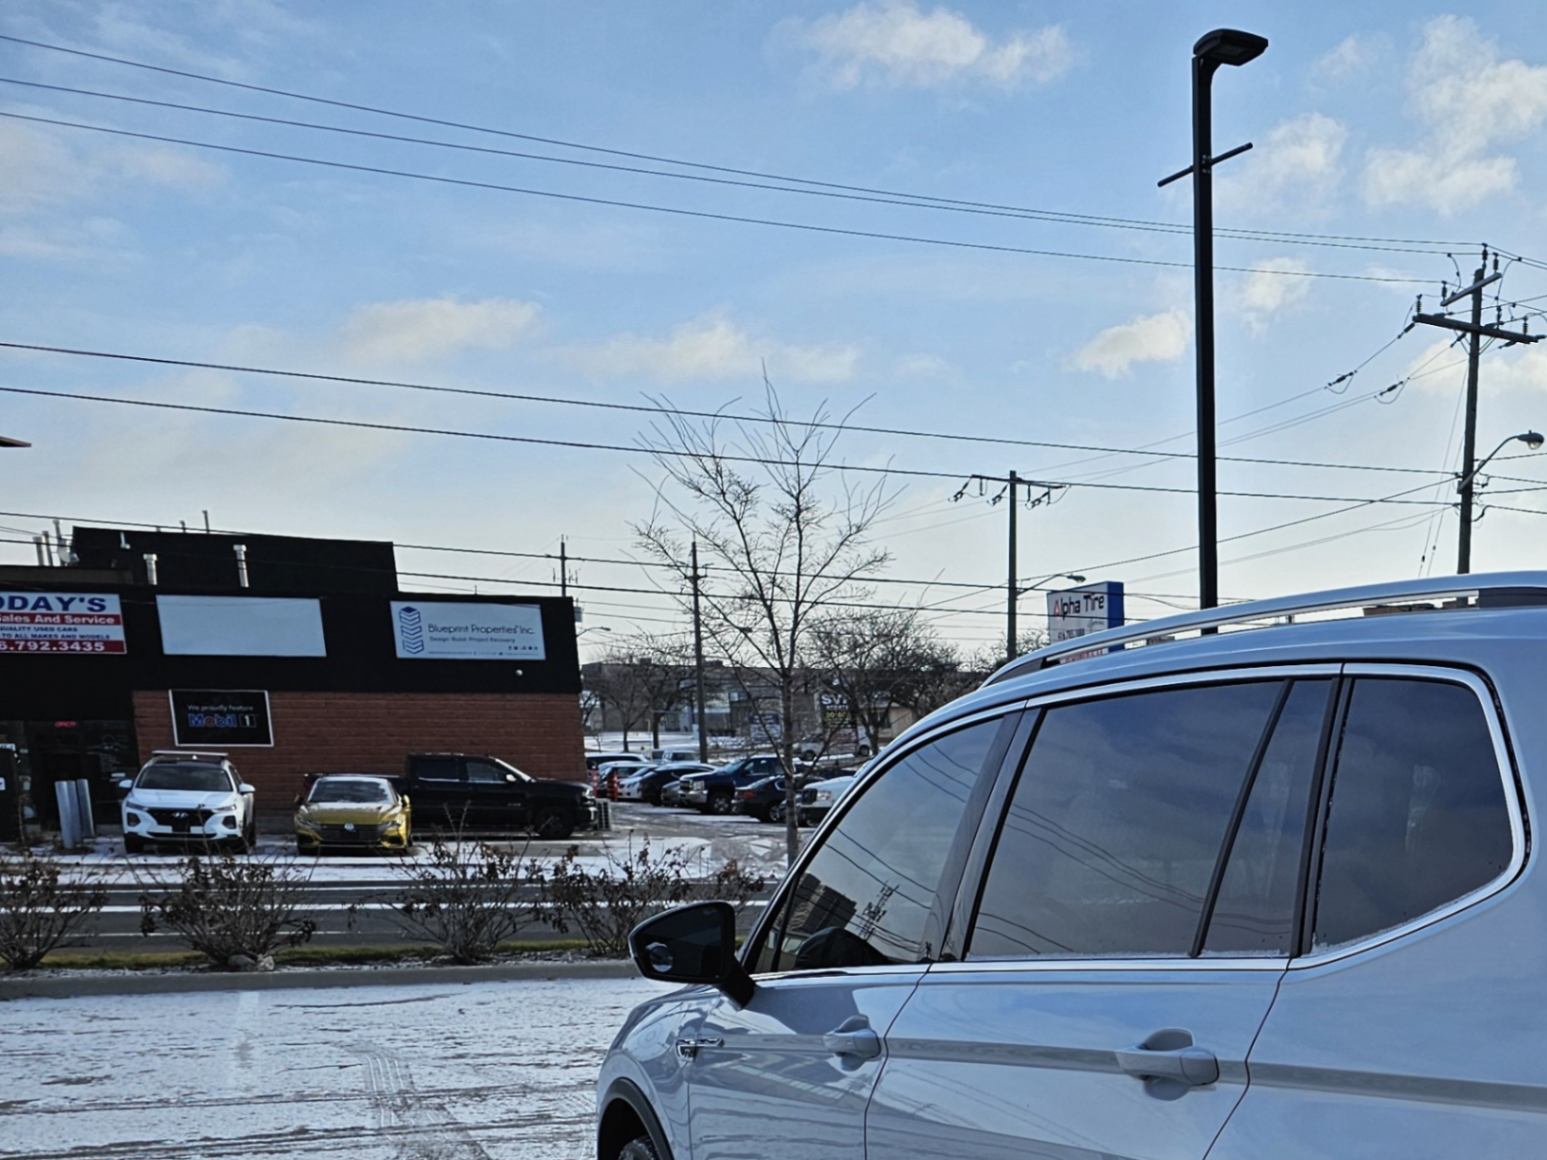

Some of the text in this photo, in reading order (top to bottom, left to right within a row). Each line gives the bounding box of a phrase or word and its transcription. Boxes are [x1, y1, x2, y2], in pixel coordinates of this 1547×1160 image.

[0, 596, 107, 612] DAY'S
[1053, 596, 1081, 620] Alpha
[0, 614, 115, 624] ales And Service
[428, 624, 536, 635] Blueprint Properties Inc.
[187, 713, 238, 728] Mobil
